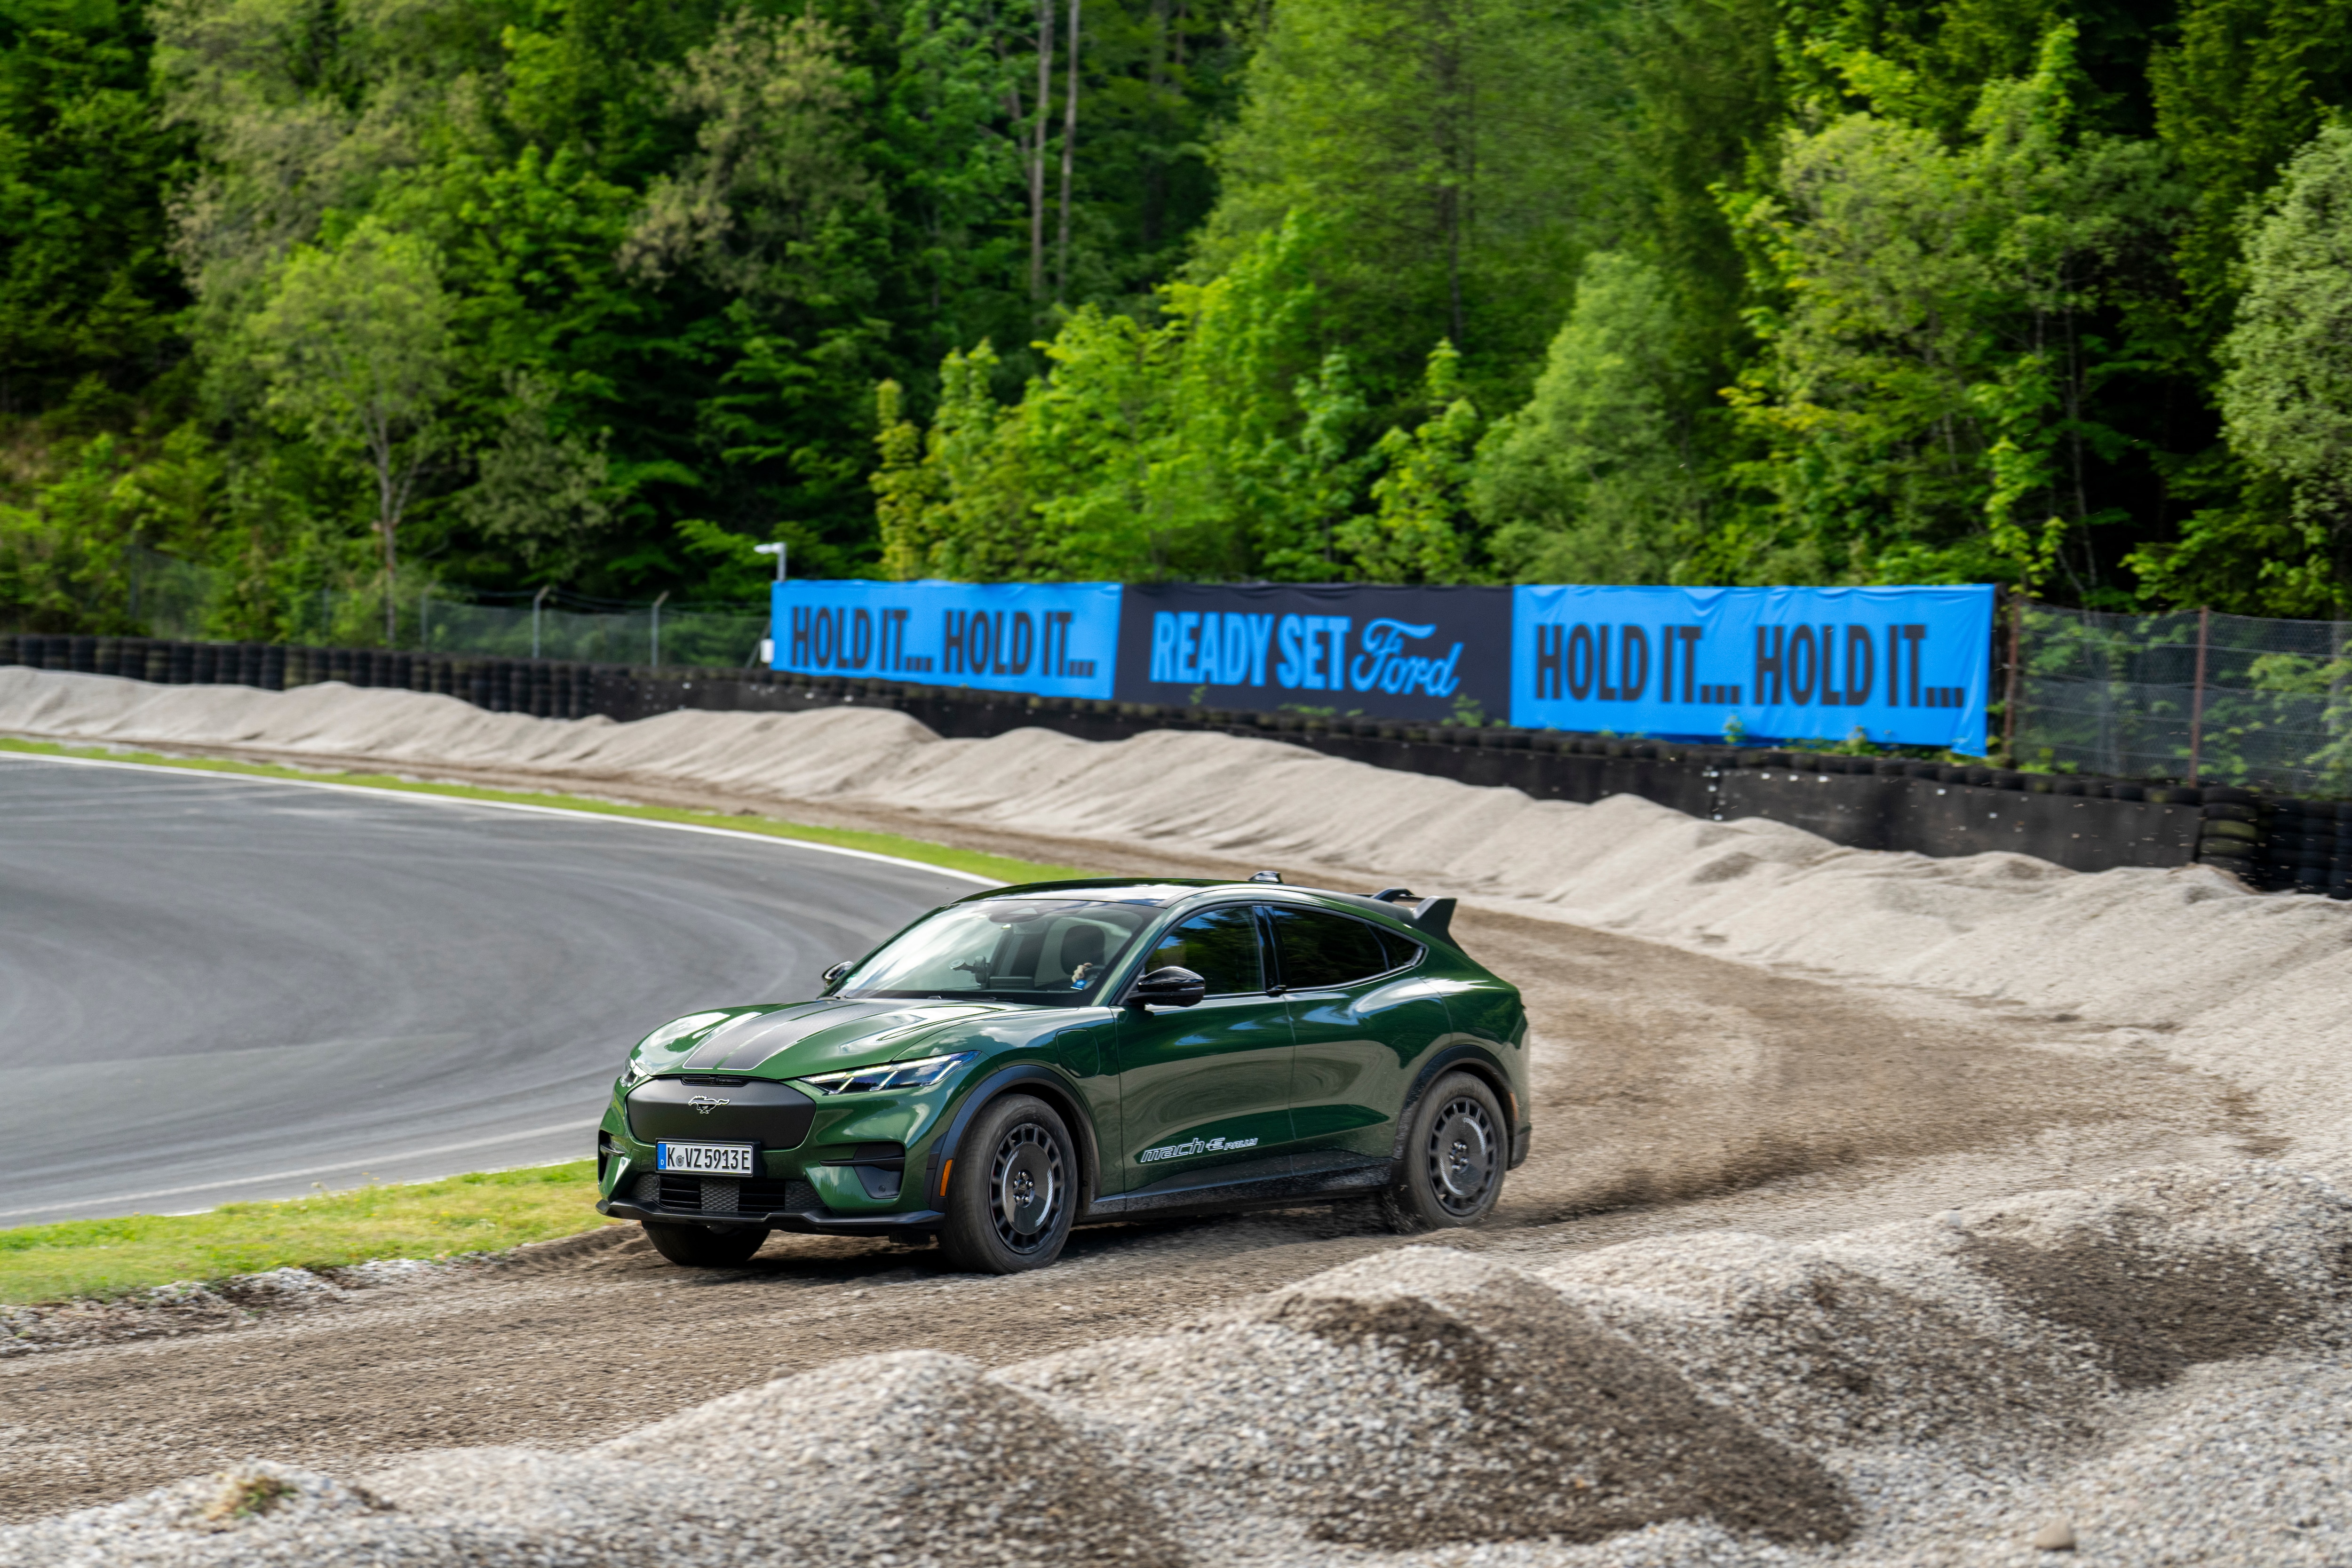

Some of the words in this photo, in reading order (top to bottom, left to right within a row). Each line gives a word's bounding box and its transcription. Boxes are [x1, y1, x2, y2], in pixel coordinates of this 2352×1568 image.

[792, 607, 872, 669] HOLD
[882, 610, 933, 671] IT...
[945, 611, 1033, 675] HOLD
[1042, 612, 1095, 677] IT...
[1151, 612, 1274, 686] READY
[1277, 614, 1351, 691] SET
[1351, 618, 1464, 698] Ford
[1536, 624, 1649, 701] HOLD
[1662, 626, 1740, 704] IT...
[1755, 624, 1874, 706] HOLD
[1888, 624, 1963, 708] IT...
